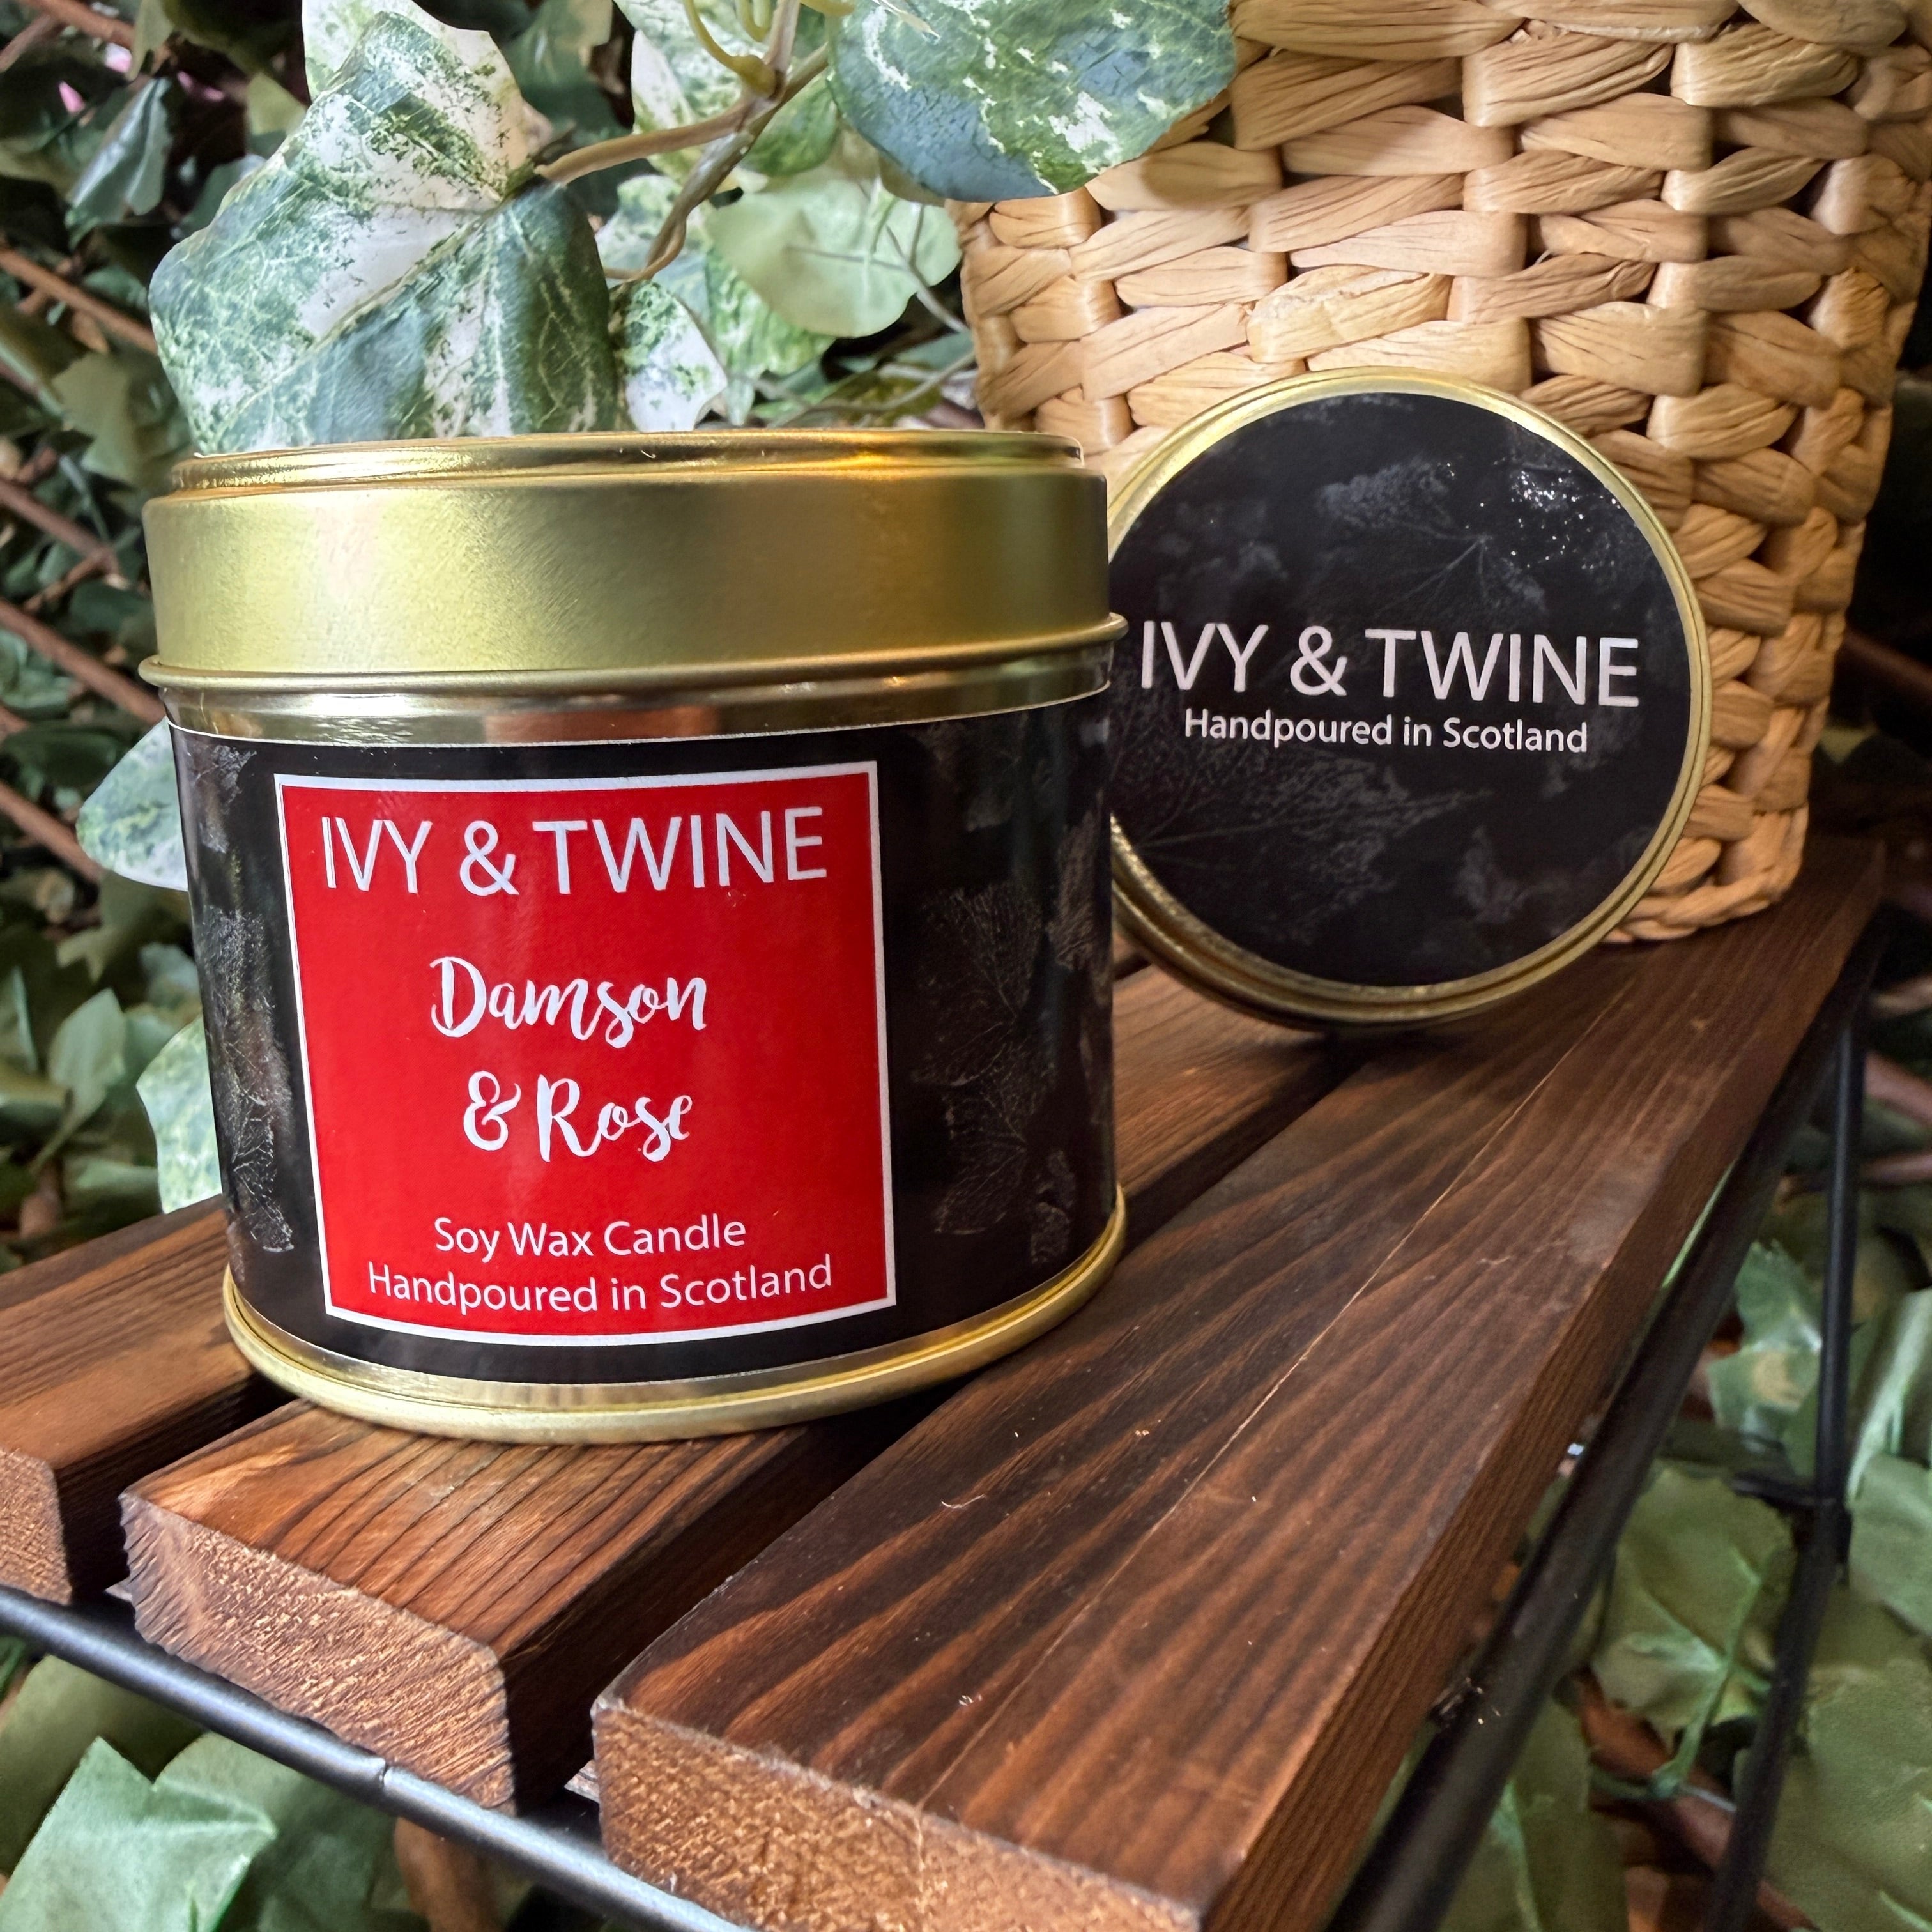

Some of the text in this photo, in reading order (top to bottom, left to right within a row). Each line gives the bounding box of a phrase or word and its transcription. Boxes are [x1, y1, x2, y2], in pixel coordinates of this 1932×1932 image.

[1141, 620, 1640, 708] IVY & TWINE
[1184, 707, 1588, 754] Handpoured in Scotland
[321, 806, 827, 897] IVY & TWINE
[429, 956, 707, 1050] Damson
[462, 1070, 693, 1163] & Rose
[433, 1212, 747, 1264] Soy Wax Candle
[368, 1252, 833, 1316] Handpoured in Scotland
